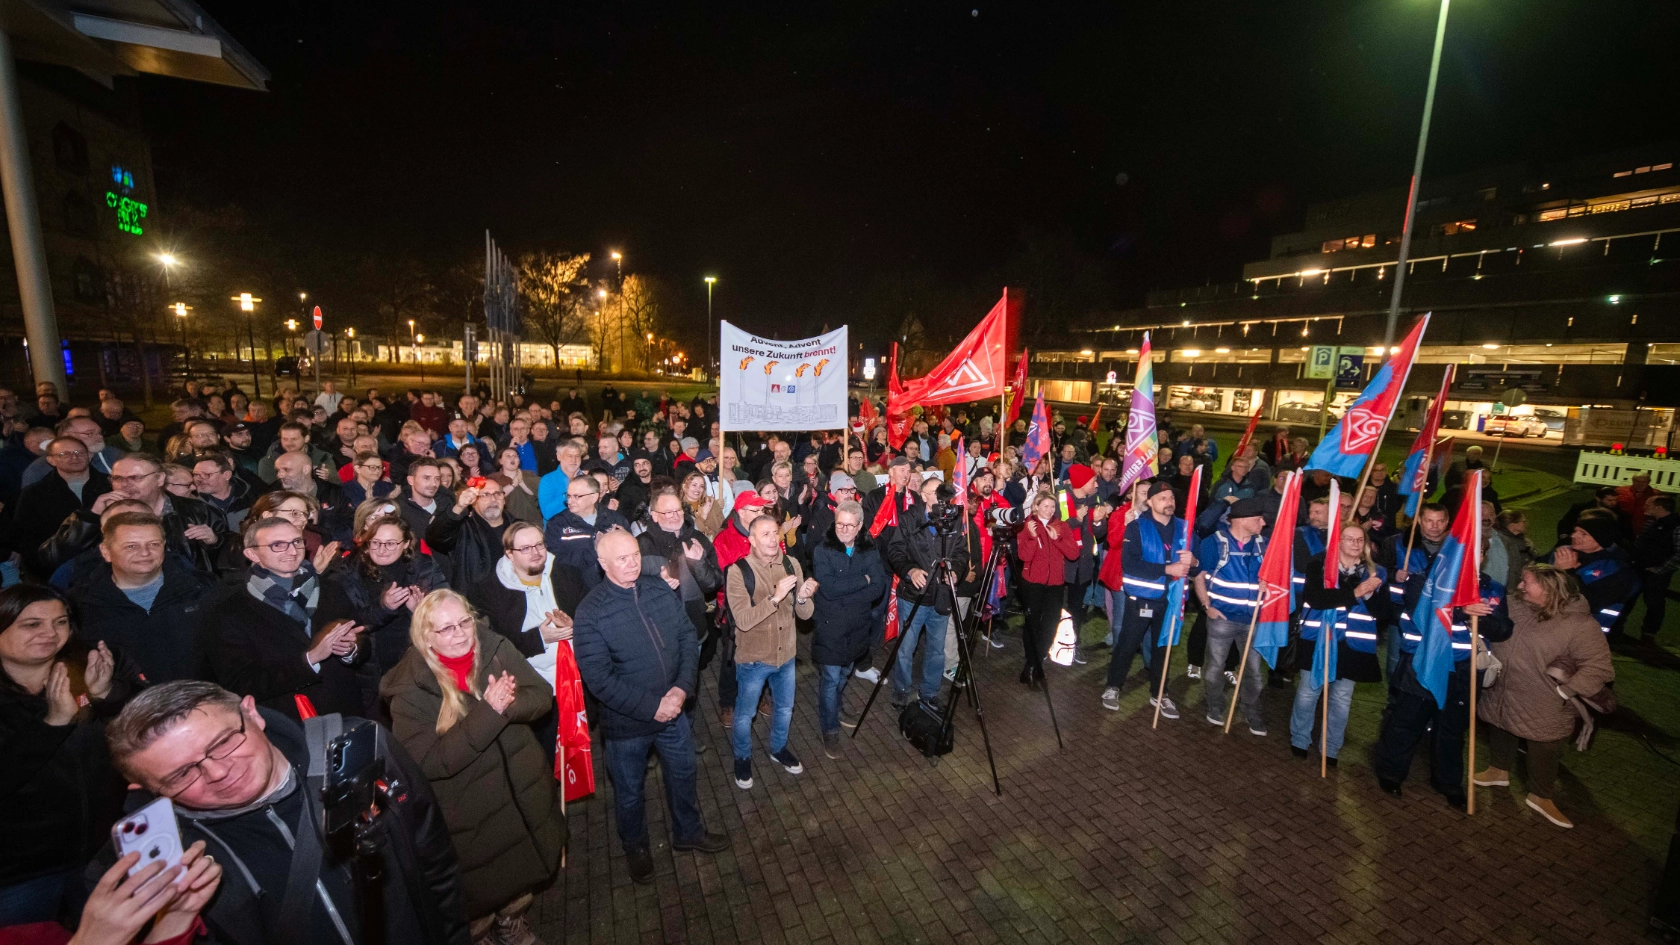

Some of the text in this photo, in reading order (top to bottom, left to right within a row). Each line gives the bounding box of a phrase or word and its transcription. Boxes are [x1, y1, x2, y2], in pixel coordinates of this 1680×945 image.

[732, 344, 836, 359] unsere Zukunft brennt!
